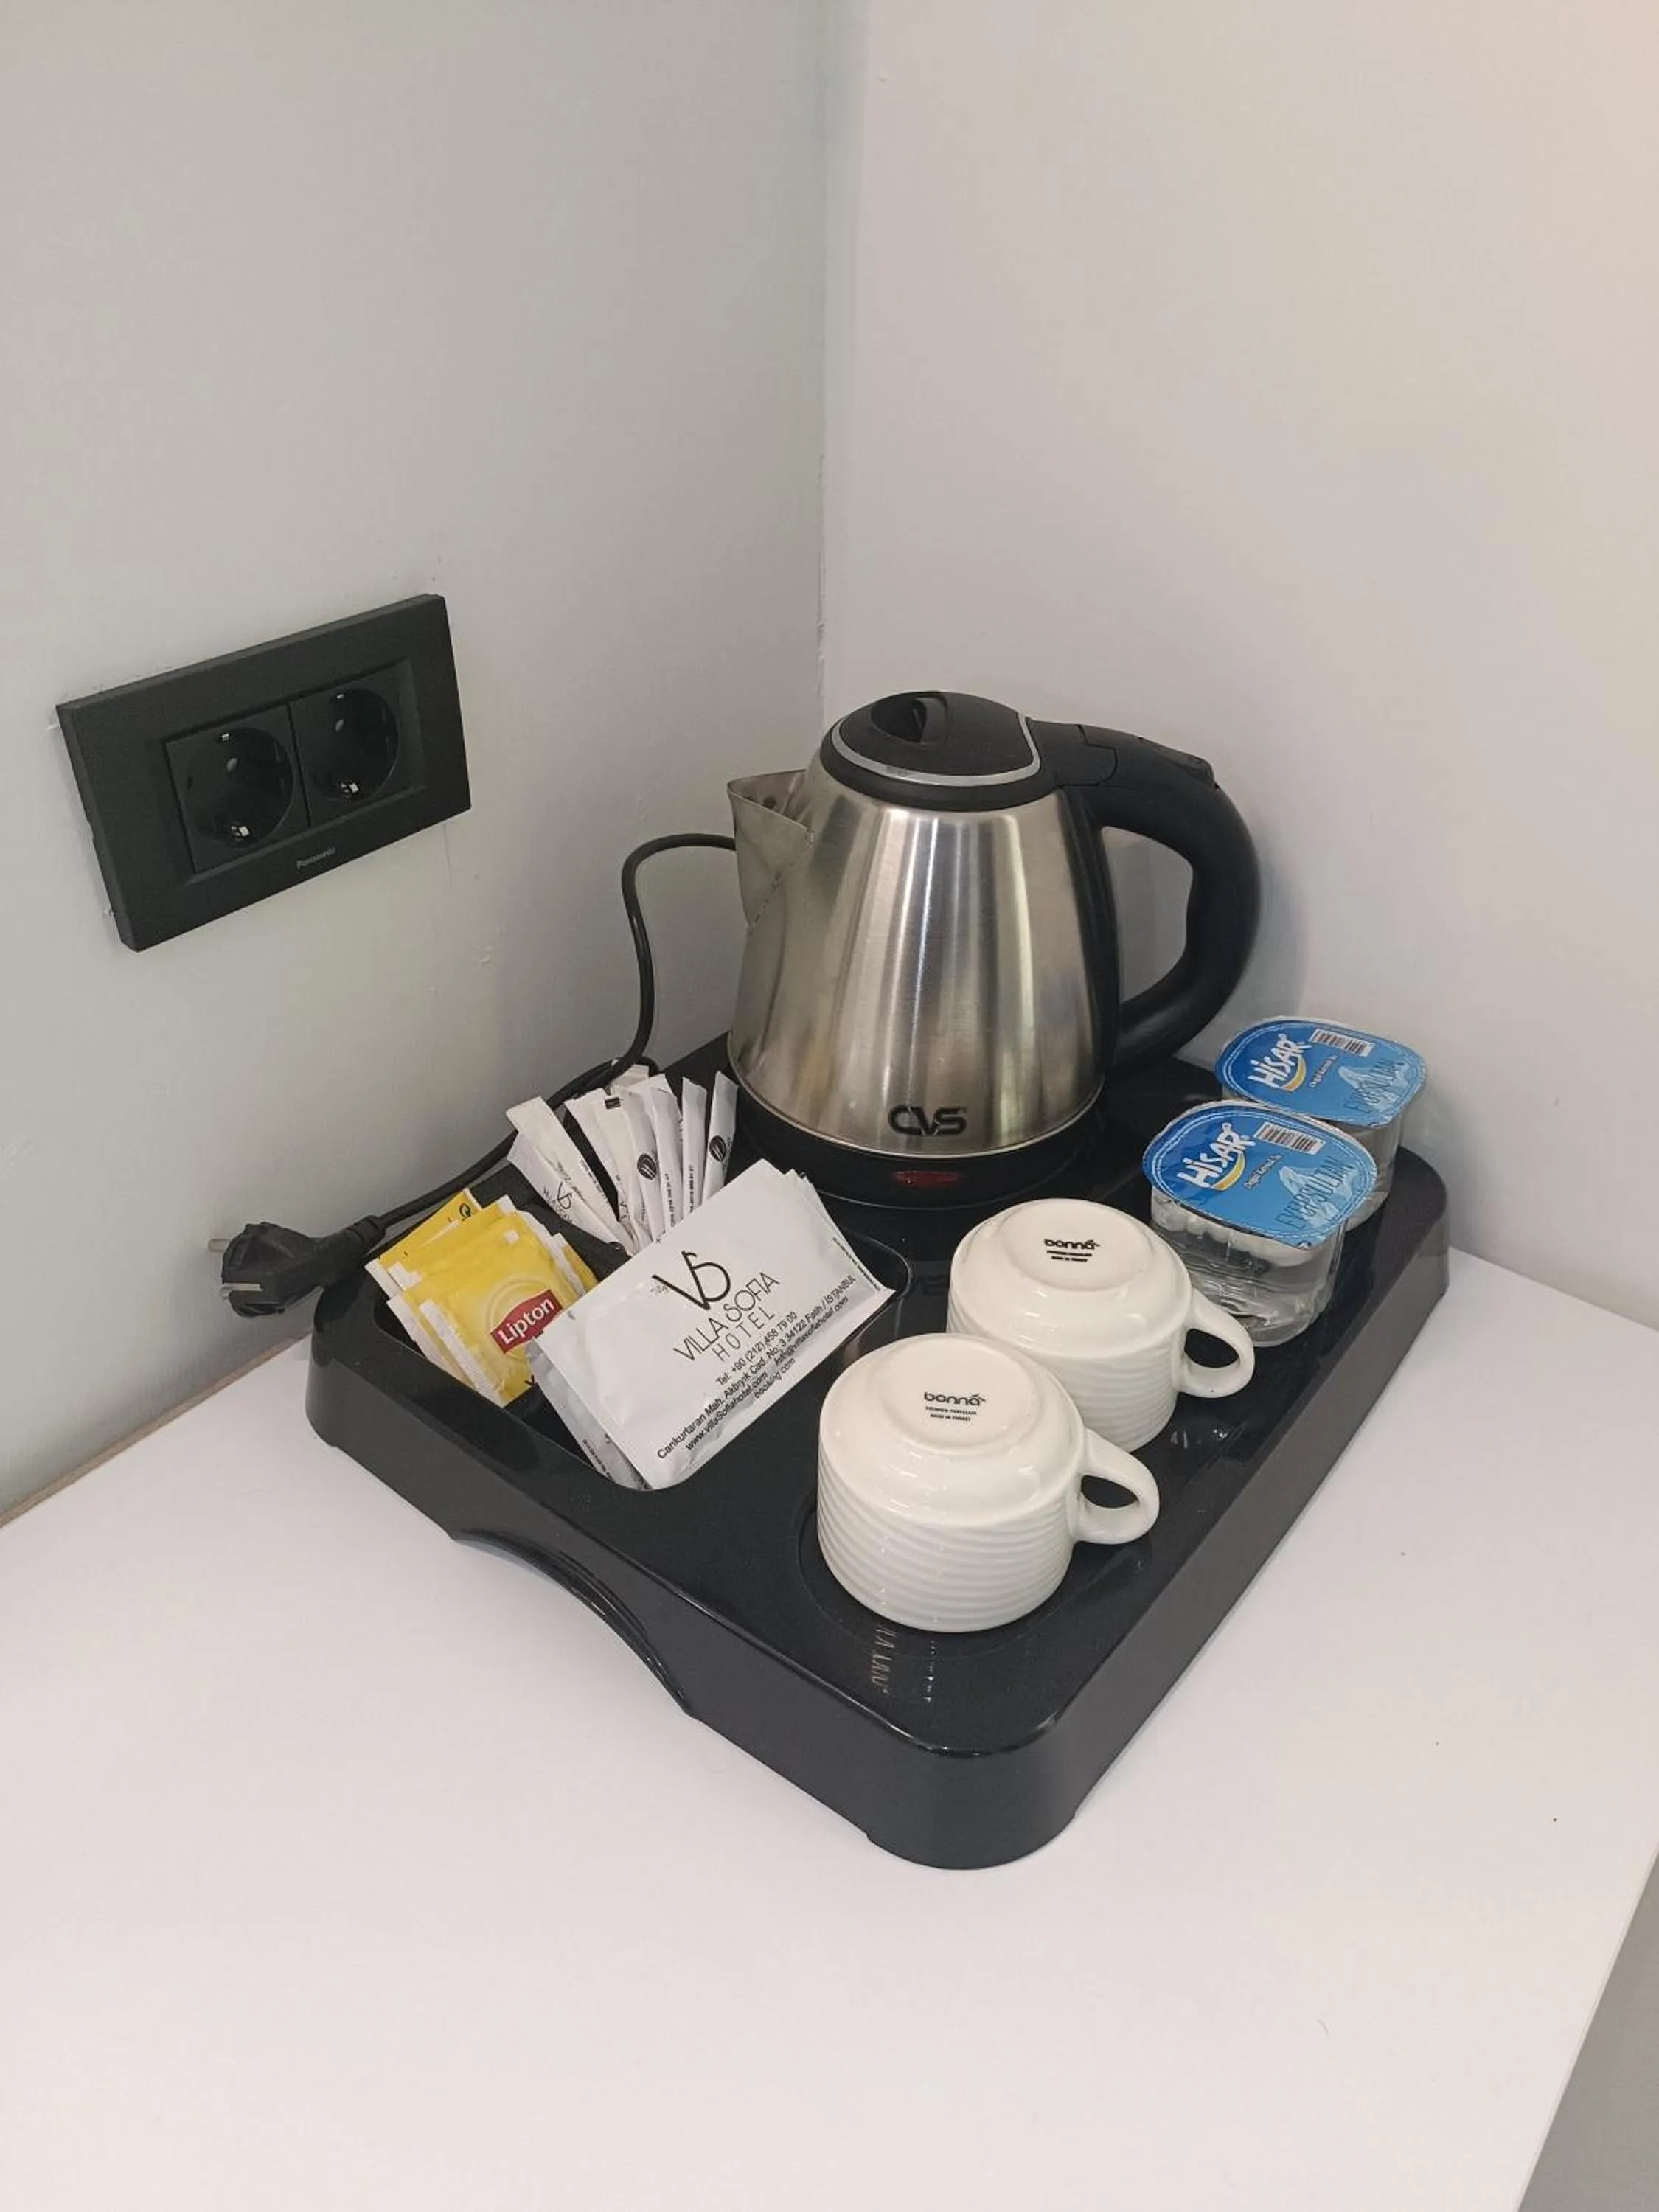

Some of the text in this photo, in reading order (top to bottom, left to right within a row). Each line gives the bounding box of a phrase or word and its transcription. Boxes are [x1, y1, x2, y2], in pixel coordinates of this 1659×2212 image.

[888, 1105, 967, 1136] CVS
[498, 1298, 555, 1344] Lipton
[673, 1272, 779, 1360] VILLA SOFIA
[712, 1306, 775, 1363] HOTEL
[785, 1310, 797, 1324] 00
[657, 1413, 706, 1459] Cankurtaran
